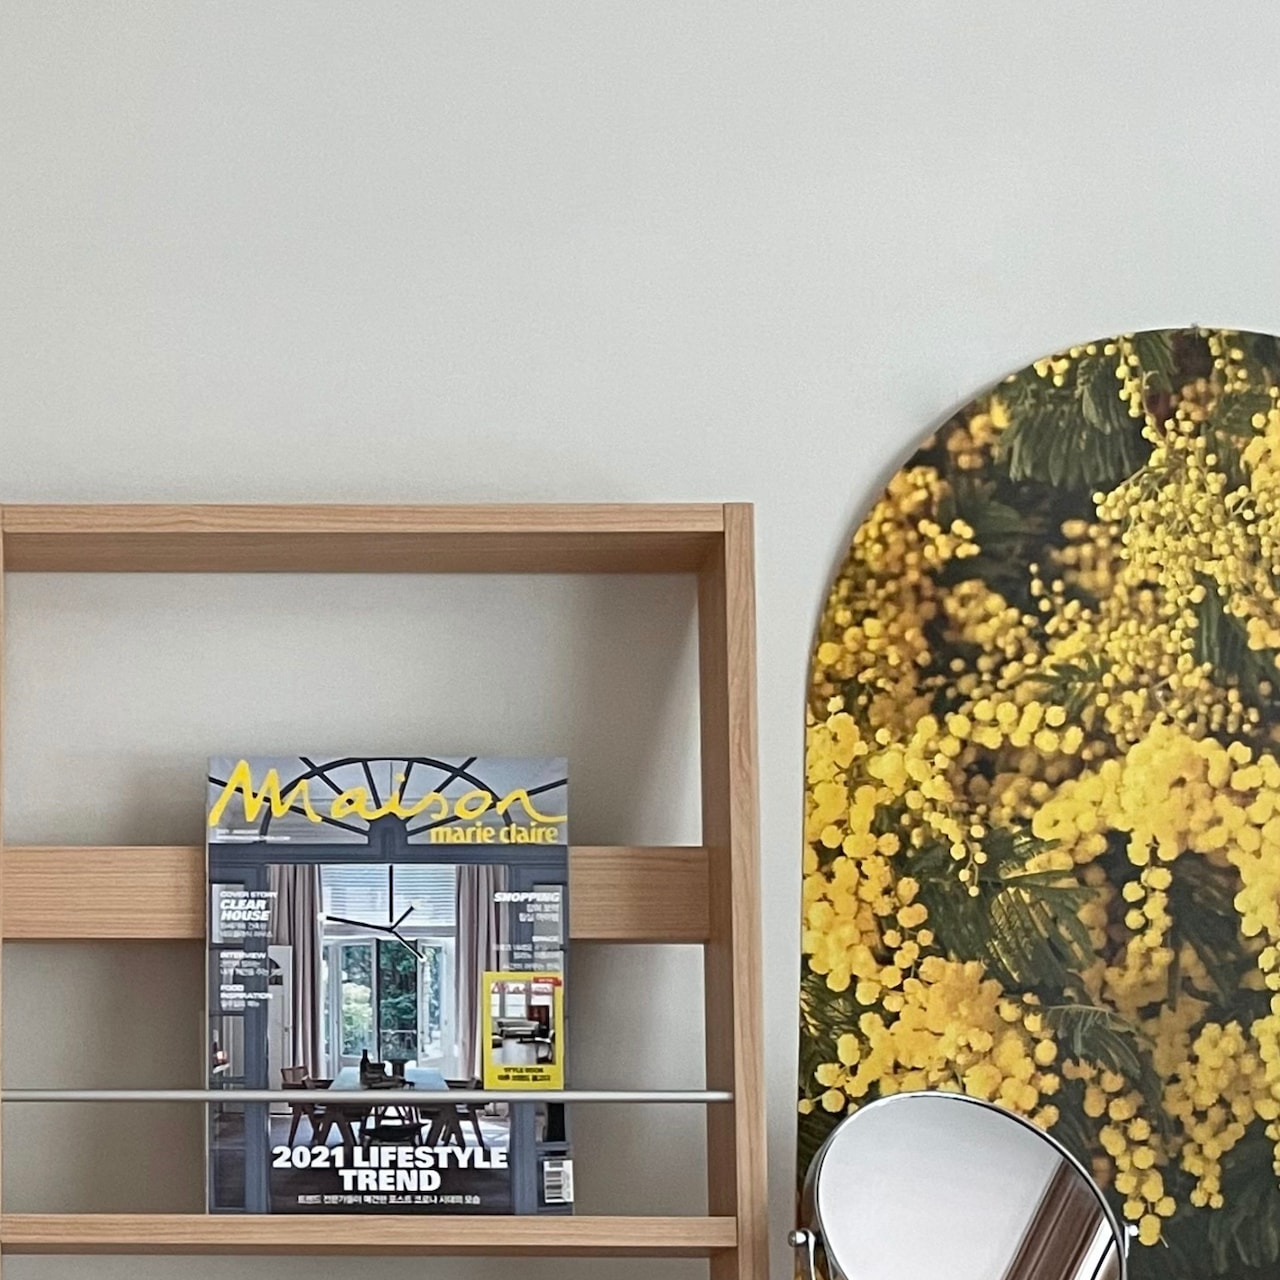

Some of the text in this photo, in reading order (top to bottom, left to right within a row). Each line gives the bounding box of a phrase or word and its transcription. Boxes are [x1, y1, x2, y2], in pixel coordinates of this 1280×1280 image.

[209, 760, 568, 827] Maison
[430, 821, 559, 844] marie claire
[220, 899, 267, 910] CLEAR
[494, 892, 561, 902] SHOPPING
[221, 910, 271, 921] HOUSE
[272, 1146, 509, 1169] 2021 LIFESTYLE
[338, 1169, 442, 1191] TREND
